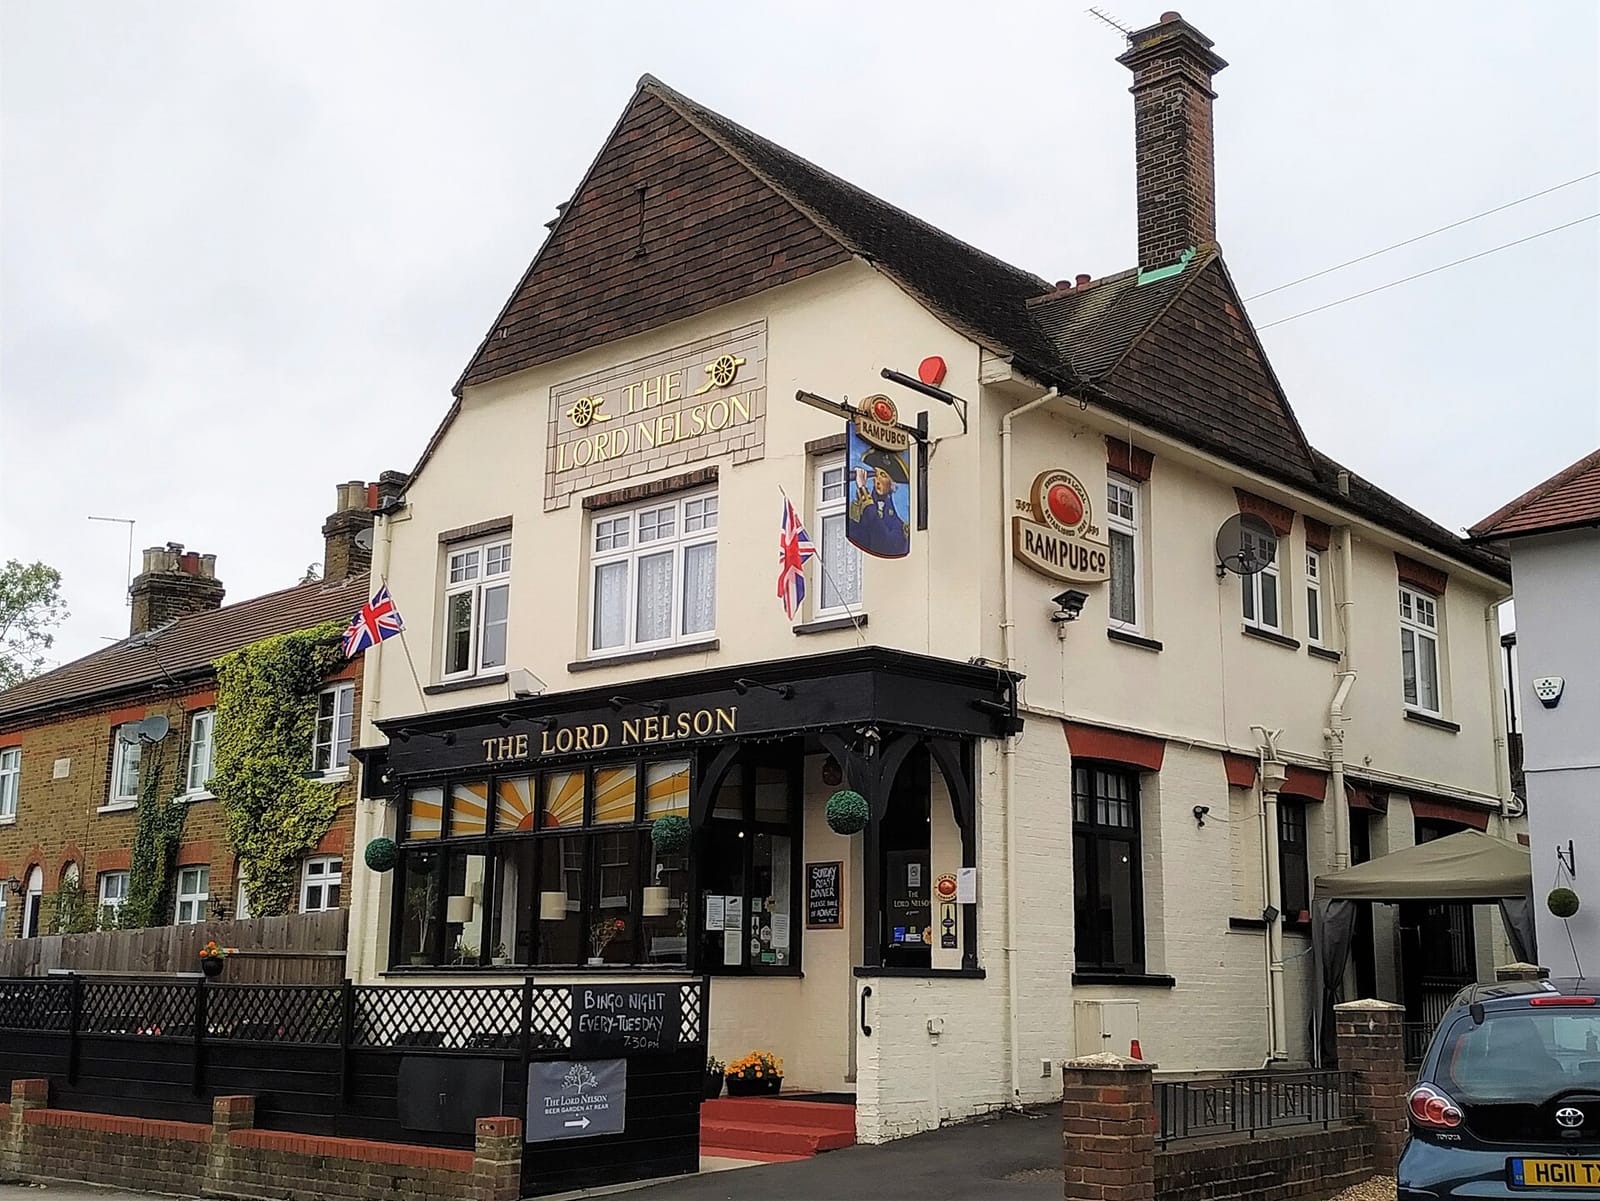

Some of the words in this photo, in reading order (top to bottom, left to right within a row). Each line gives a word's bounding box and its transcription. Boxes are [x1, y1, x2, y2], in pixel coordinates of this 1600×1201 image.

[622, 371, 683, 414] THE
[557, 428, 630, 473] LORD
[636, 393, 753, 453] NELSON
[482, 734, 529, 762] THE
[540, 723, 610, 755] LORD
[621, 707, 738, 745] NELSON
[908, 890, 919, 898] THE
[911, 899, 931, 907] NELSO
[584, 990, 624, 1013] BINGO
[628, 992, 666, 1013] NIGHT
[560, 1095, 580, 1106] LORD
[580, 1094, 608, 1104] NELSON
[544, 1107, 561, 1115] BEER
[561, 1105, 585, 1113] GARDEN
[1435, 1133, 1462, 1141] TOYOTA
[1535, 1163, 1577, 1183] HG11
